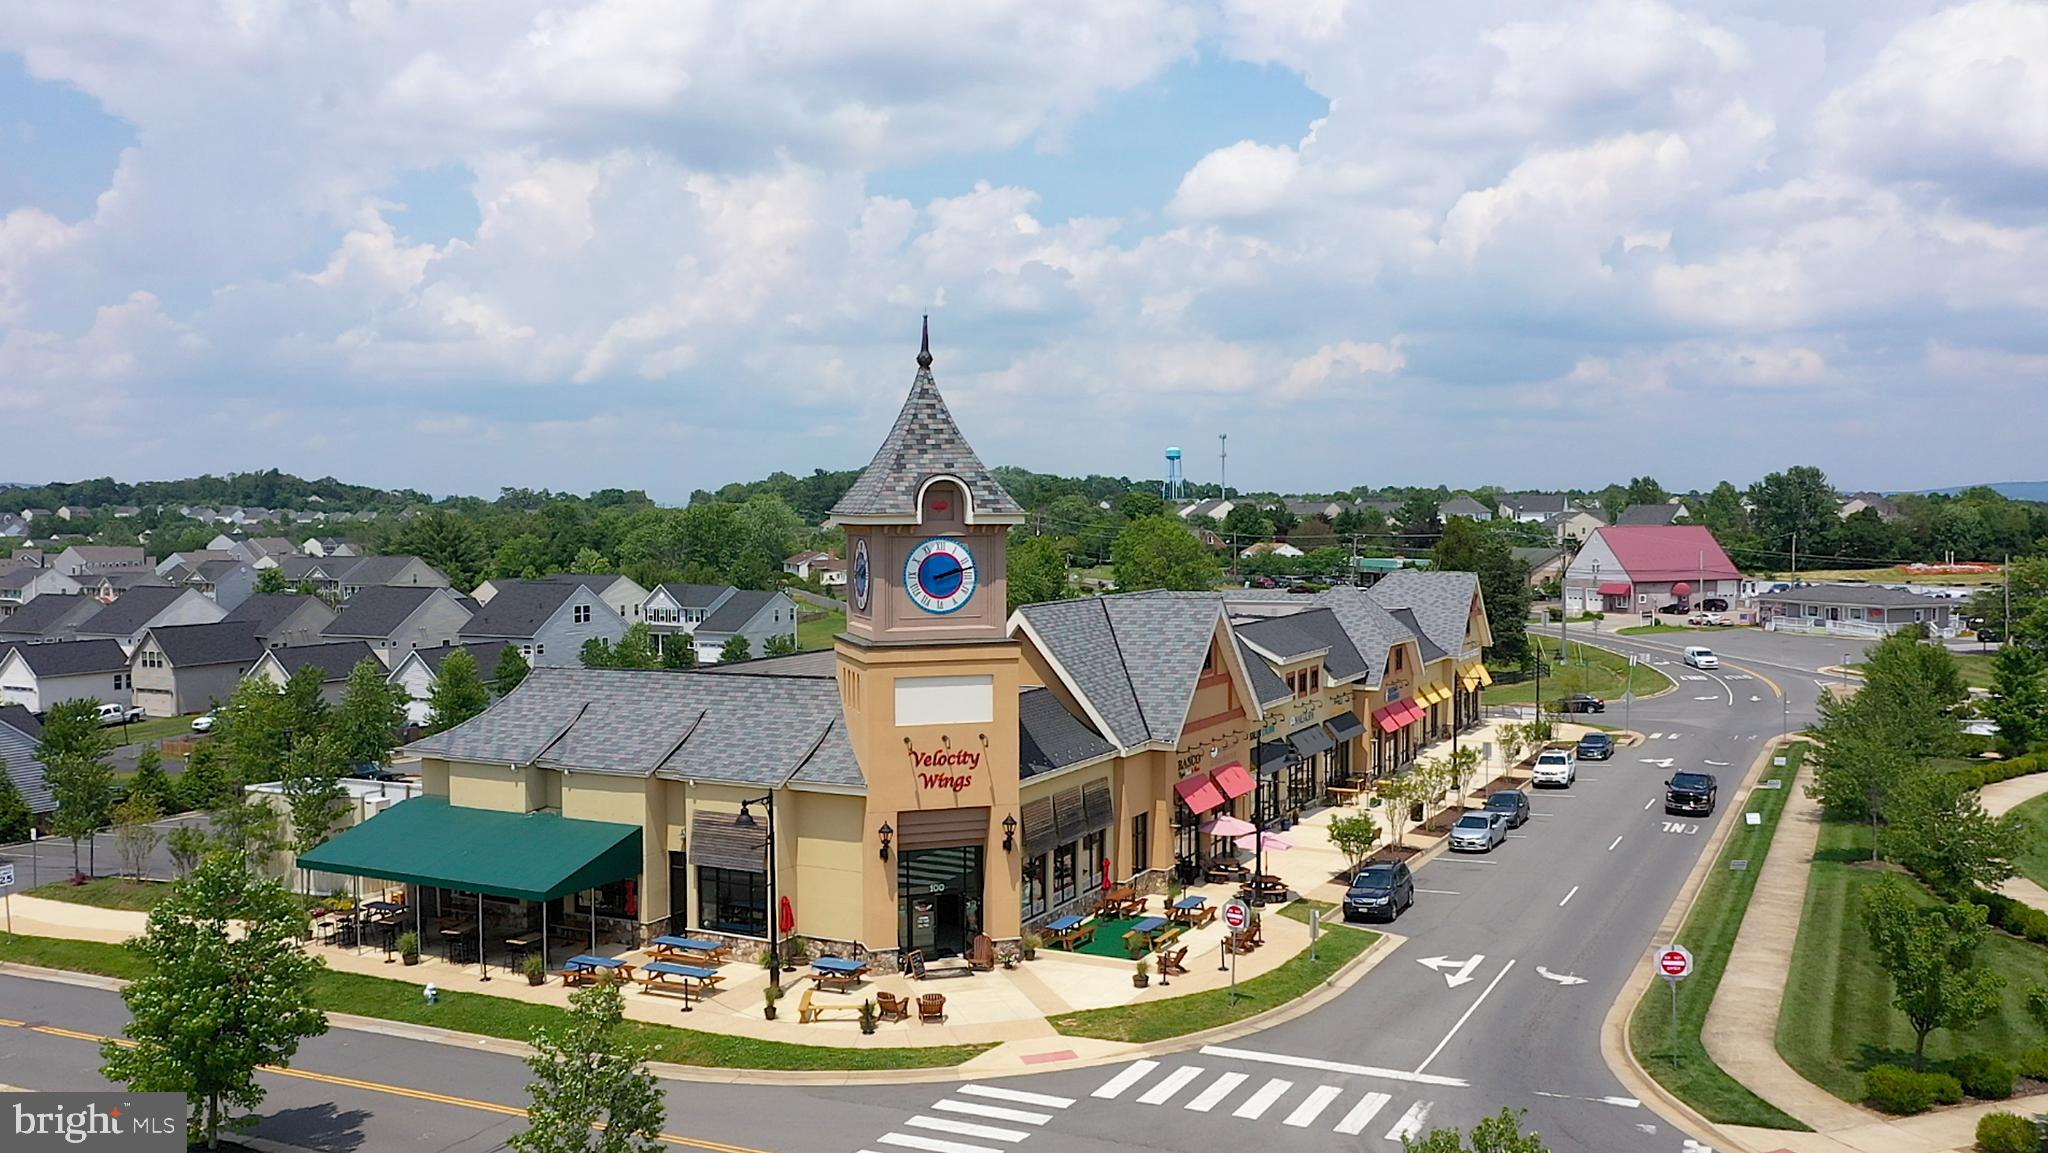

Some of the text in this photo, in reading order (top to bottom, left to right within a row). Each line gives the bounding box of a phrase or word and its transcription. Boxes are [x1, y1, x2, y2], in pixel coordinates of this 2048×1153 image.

[909, 749, 980, 769] Velocity
[918, 772, 972, 792] Wings
[929, 883, 945, 892] 100
